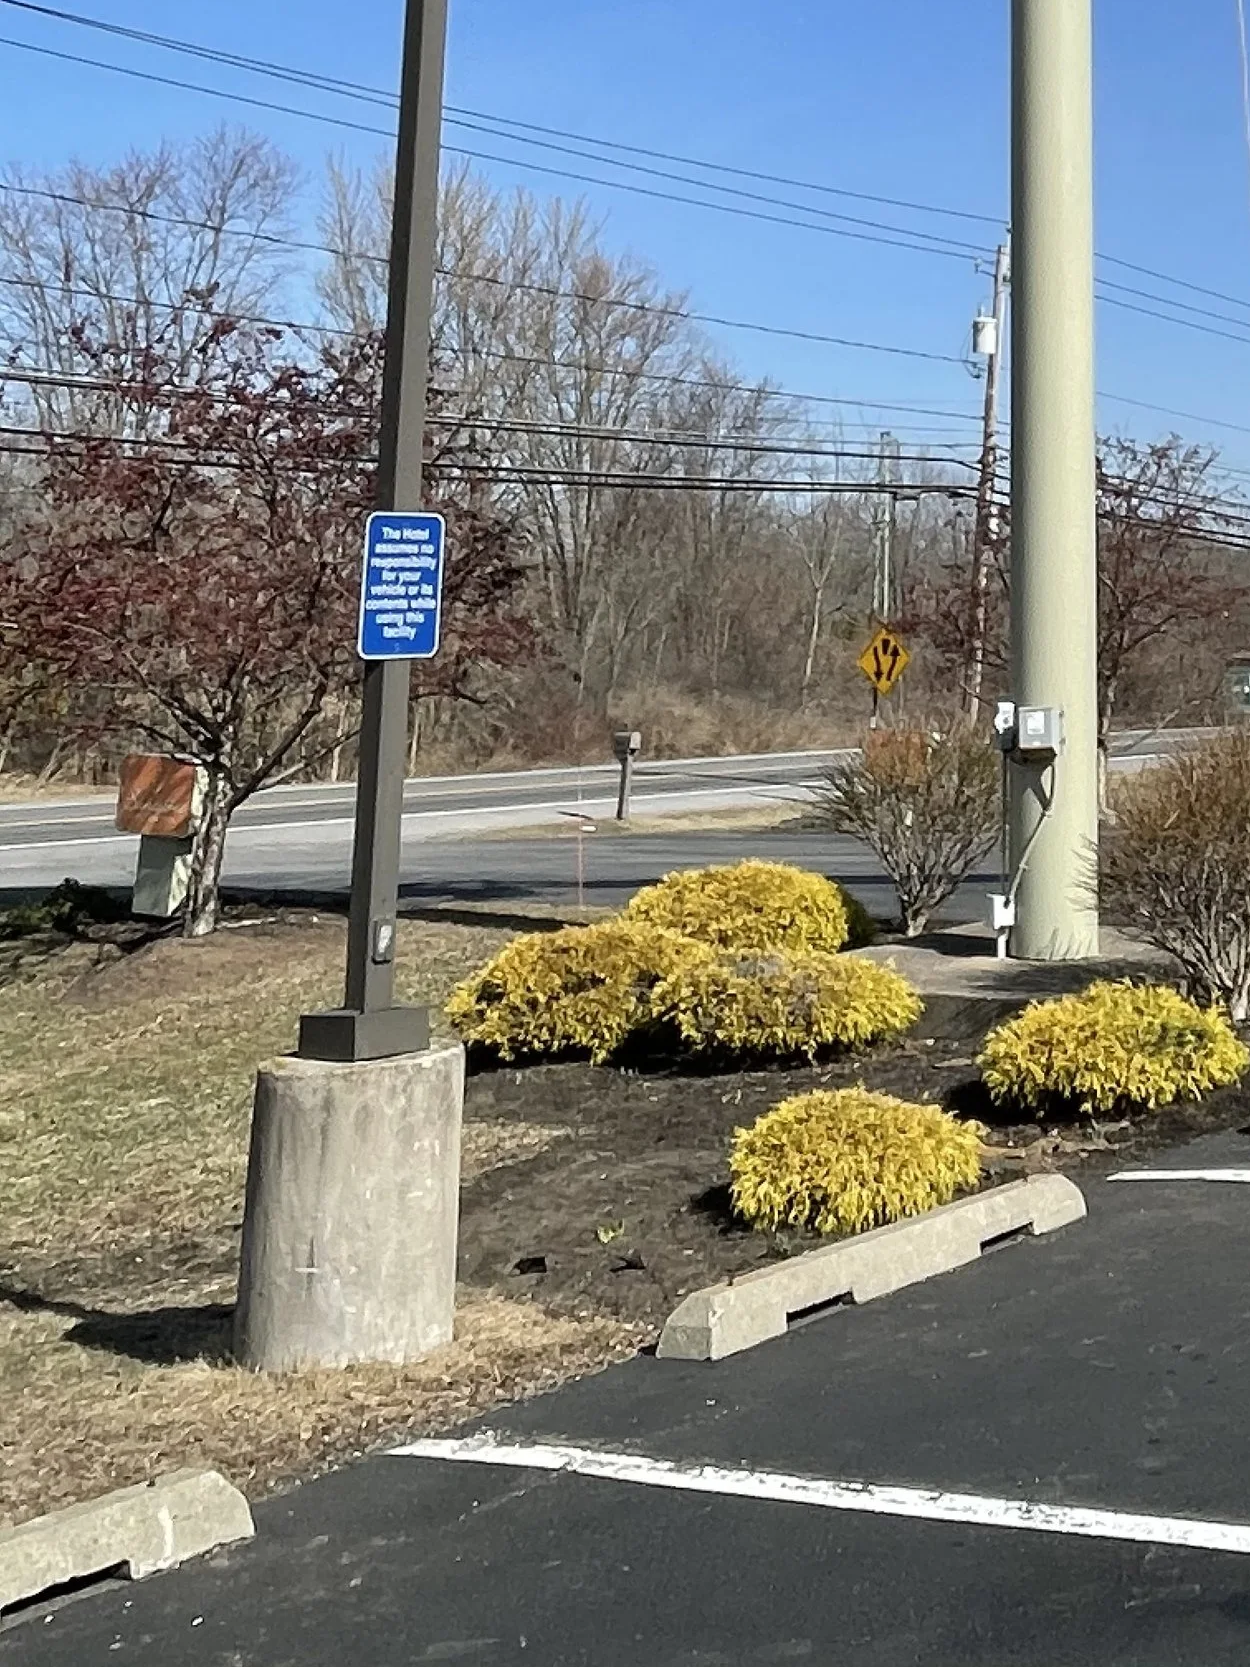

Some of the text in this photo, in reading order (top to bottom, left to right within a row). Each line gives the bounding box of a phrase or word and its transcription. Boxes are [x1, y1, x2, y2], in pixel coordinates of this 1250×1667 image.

[382, 527, 430, 540] The Hotel
[375, 543, 434, 554] assumes no
[371, 556, 437, 570] responsibility
[382, 570, 421, 584] for your
[371, 584, 433, 595] vehicle or its
[366, 597, 436, 610] contents while
[376, 612, 424, 626] using this
[383, 626, 417, 640] facility
